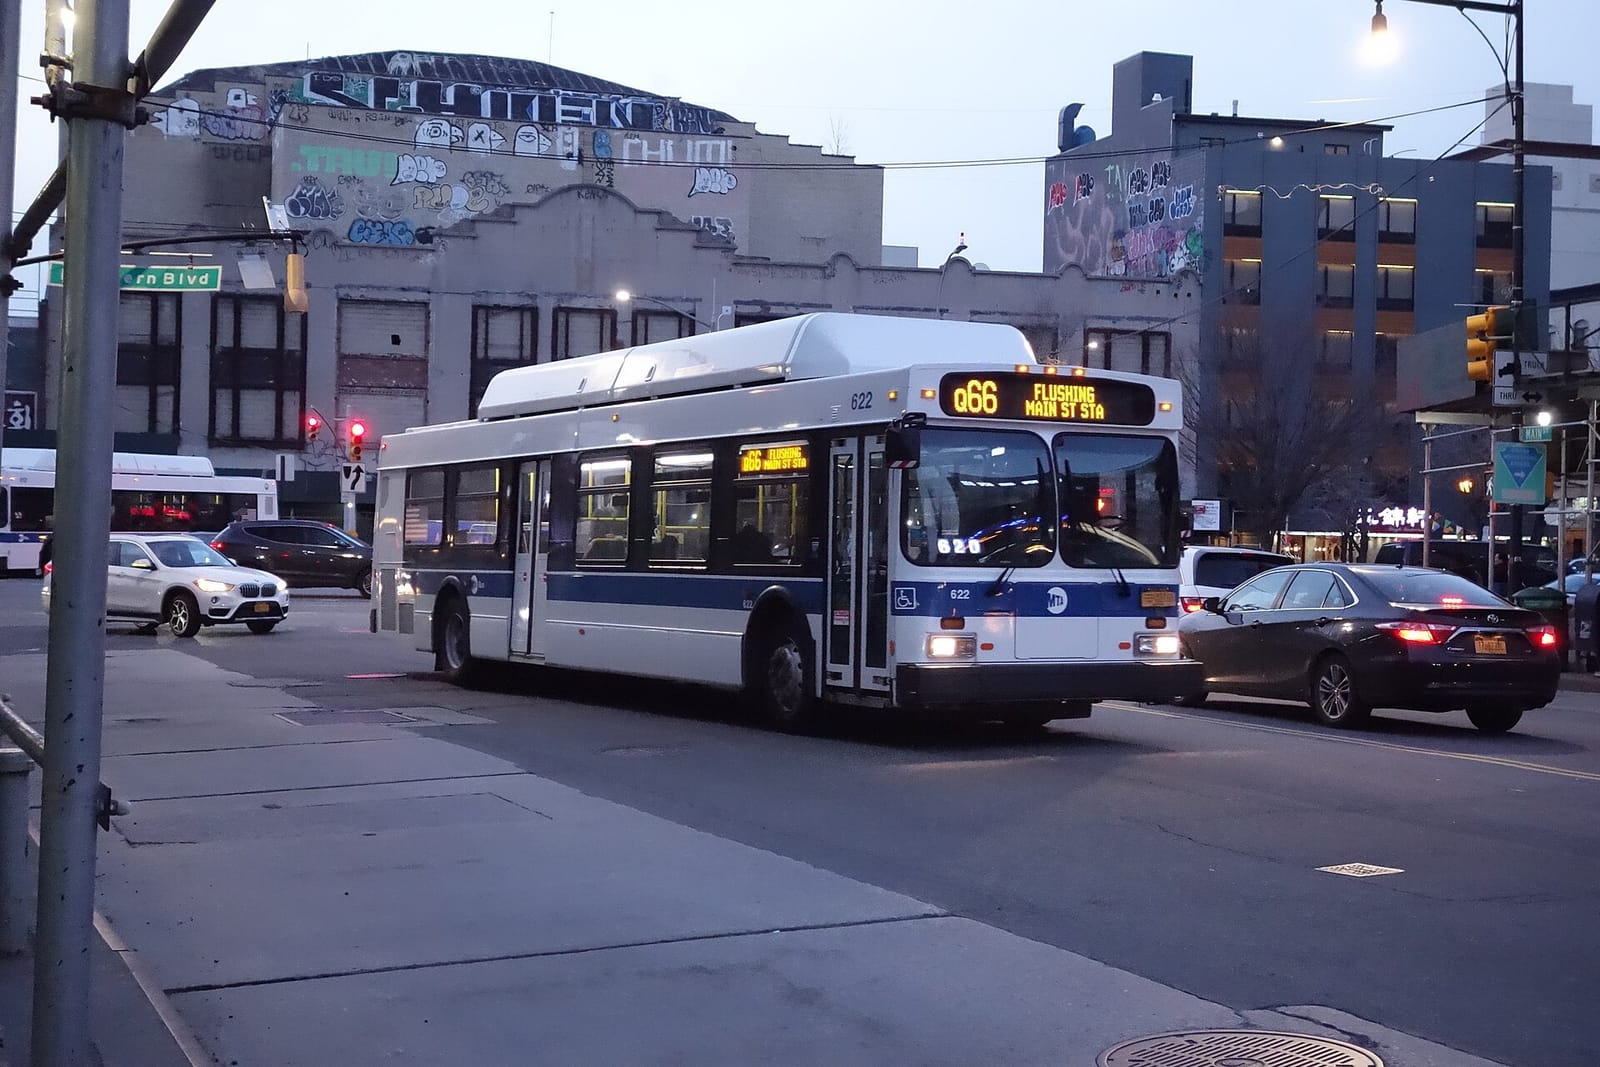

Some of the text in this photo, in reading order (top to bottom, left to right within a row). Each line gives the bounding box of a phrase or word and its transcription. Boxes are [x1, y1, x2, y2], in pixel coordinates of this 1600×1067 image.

[163, 272, 209, 285] Blvd
[954, 380, 998, 414] Q66
[1034, 383, 1096, 403] FLUSHING
[851, 391, 873, 410] 622
[1025, 400, 1105, 419] MAIN ST STA
[1525, 427, 1541, 440] MAIN
[769, 447, 801, 460] FLUSHING
[764, 457, 806, 471] MAIN ST STA
[950, 589, 970, 600] 622
